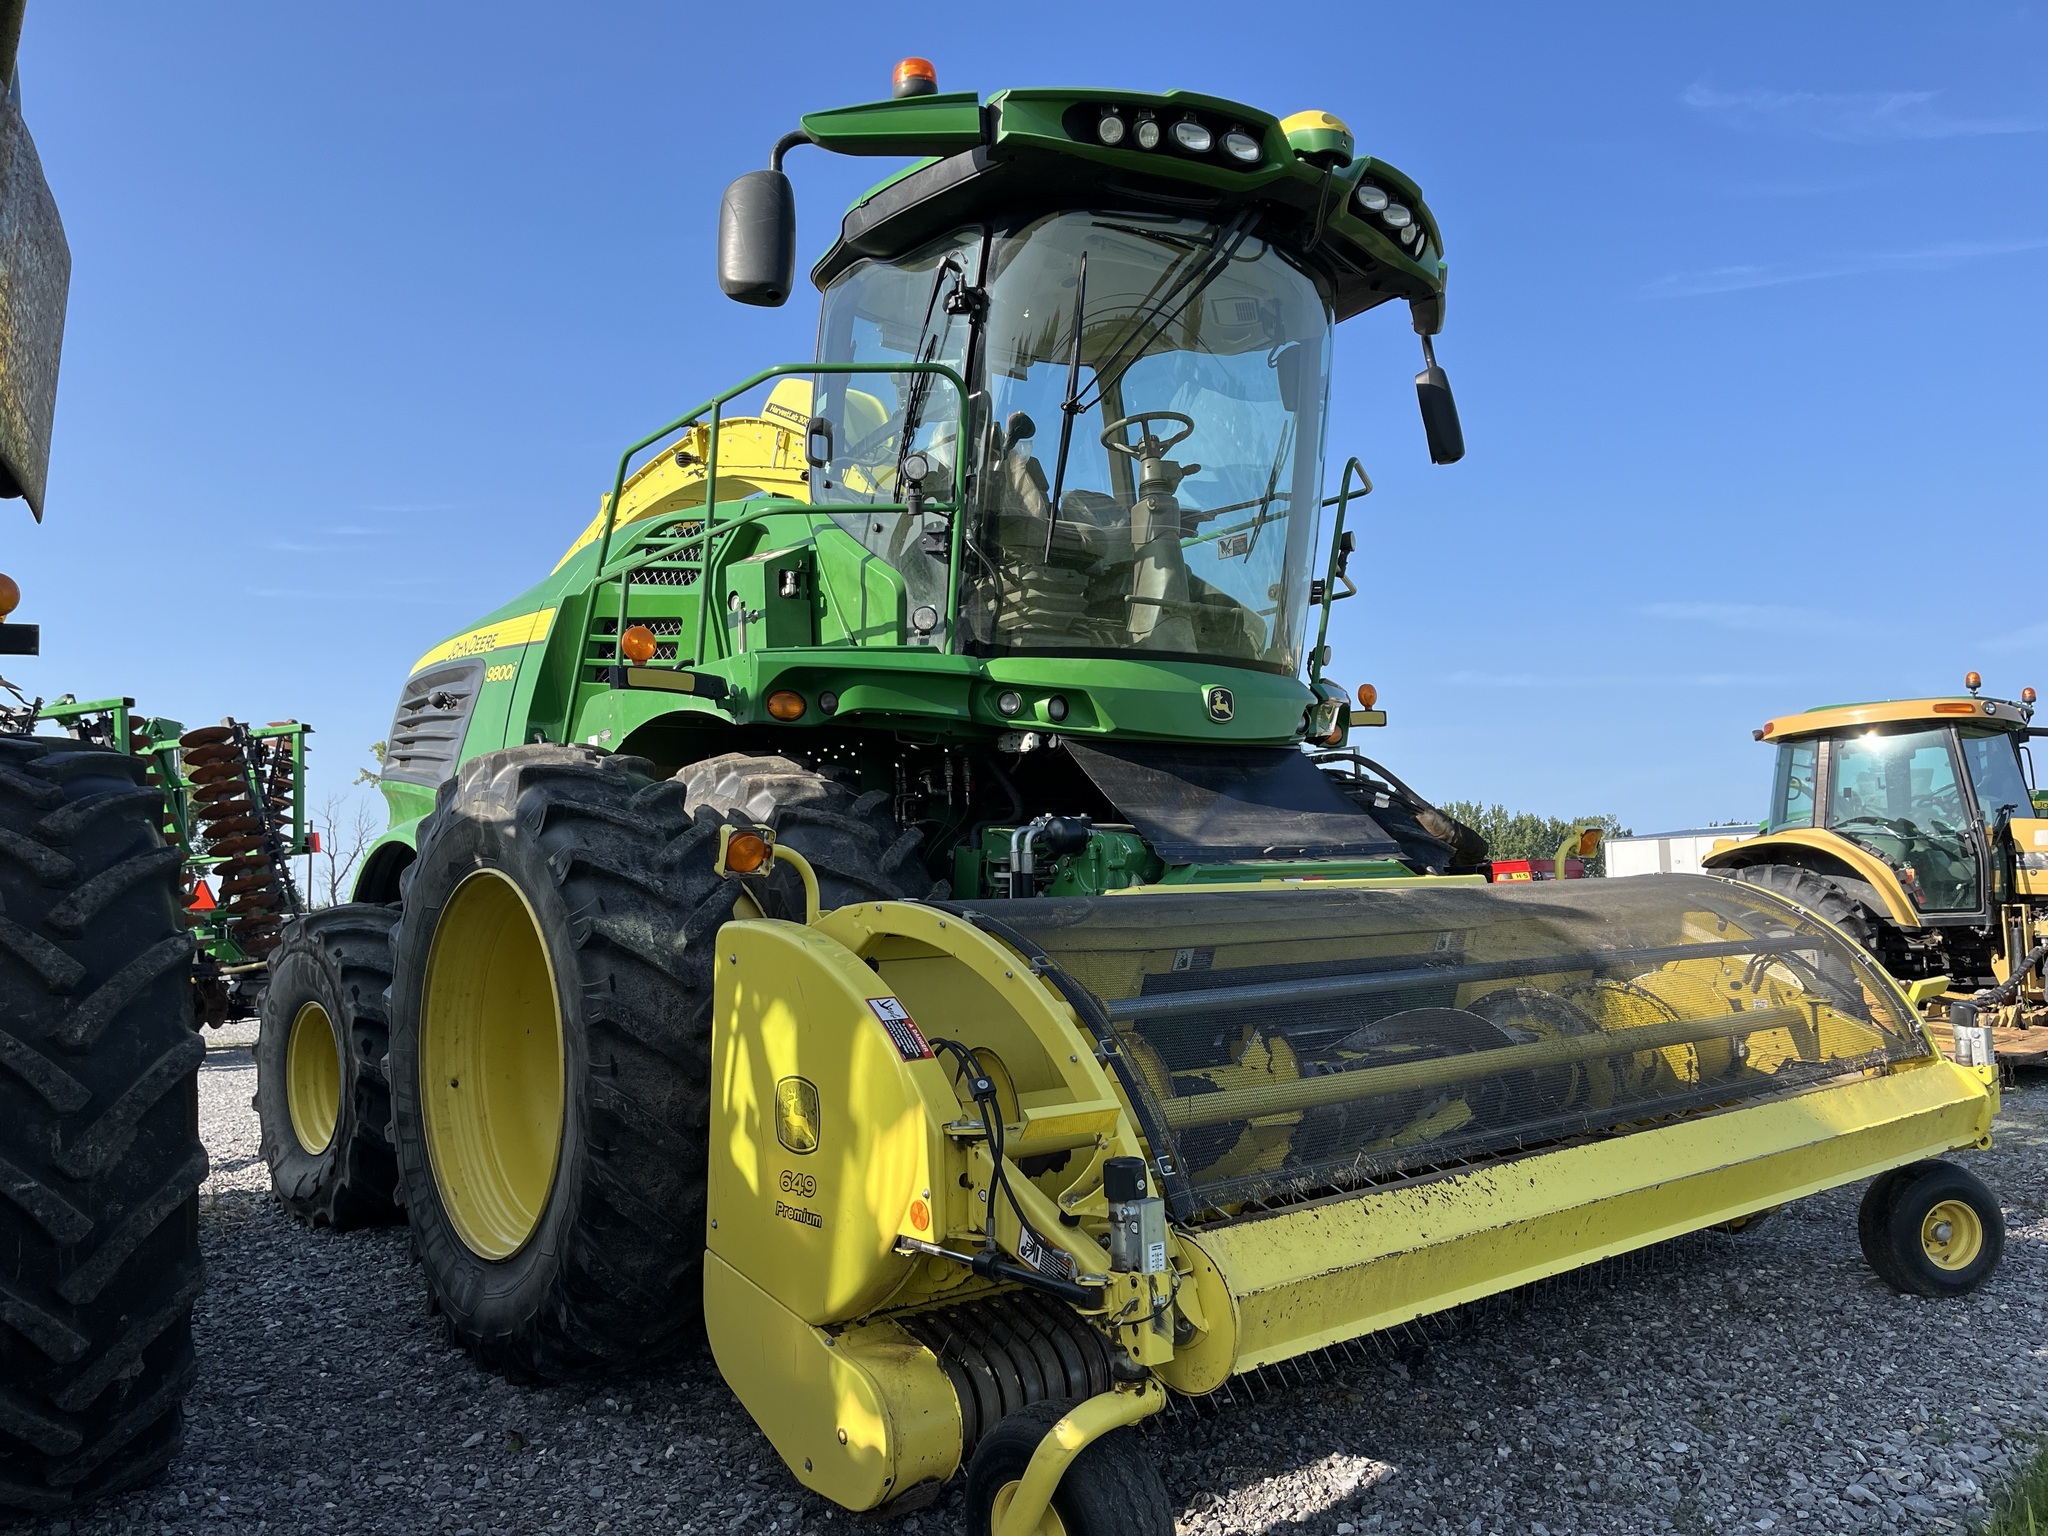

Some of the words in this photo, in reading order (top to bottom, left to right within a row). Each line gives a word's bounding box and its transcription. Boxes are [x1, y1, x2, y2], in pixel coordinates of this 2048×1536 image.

[469, 633, 499, 653] DEERE
[486, 661, 518, 682] 9800i
[911, 1027, 930, 1053] DANGER
[779, 1169, 817, 1198] 649
[775, 1200, 823, 1228] Premium
